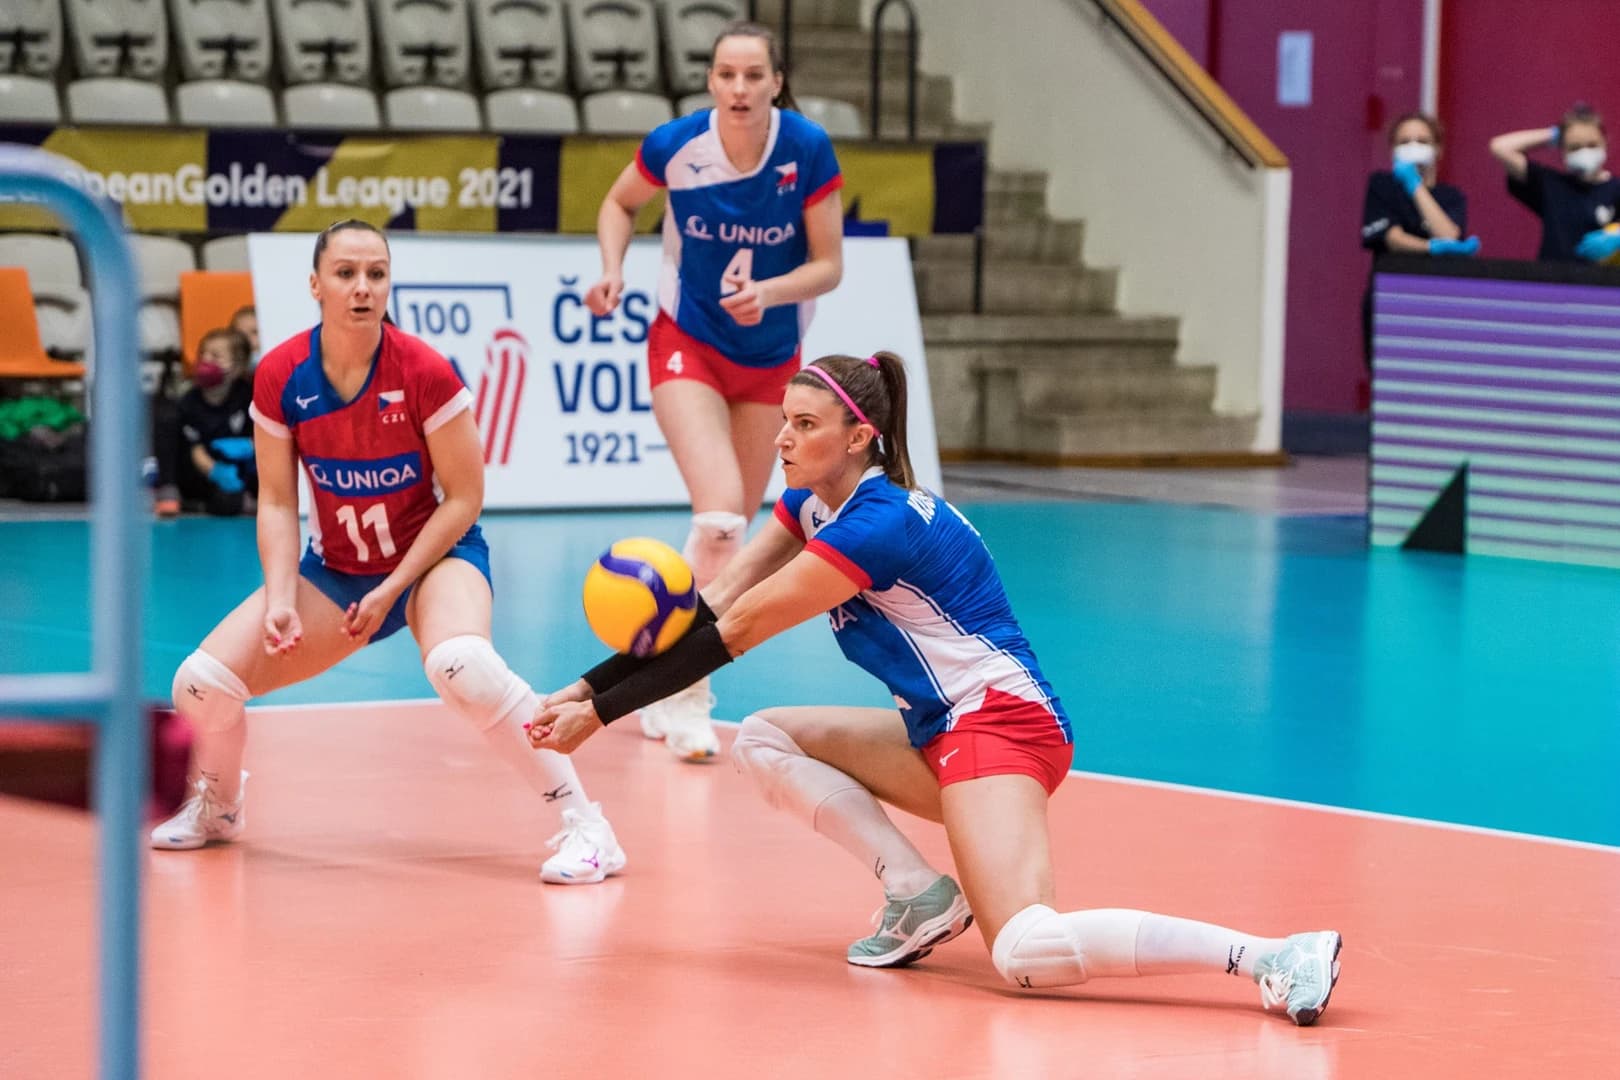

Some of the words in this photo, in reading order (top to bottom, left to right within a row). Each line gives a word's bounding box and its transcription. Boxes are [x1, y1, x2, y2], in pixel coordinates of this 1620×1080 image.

[316, 165, 450, 217] League
[457, 166, 534, 208] 2021
[718, 222, 795, 246] UNIQA
[719, 248, 753, 296] 4
[408, 302, 471, 335] 100
[666, 350, 684, 375] 4
[335, 463, 418, 490] UNIQA
[335, 502, 398, 563] 11
